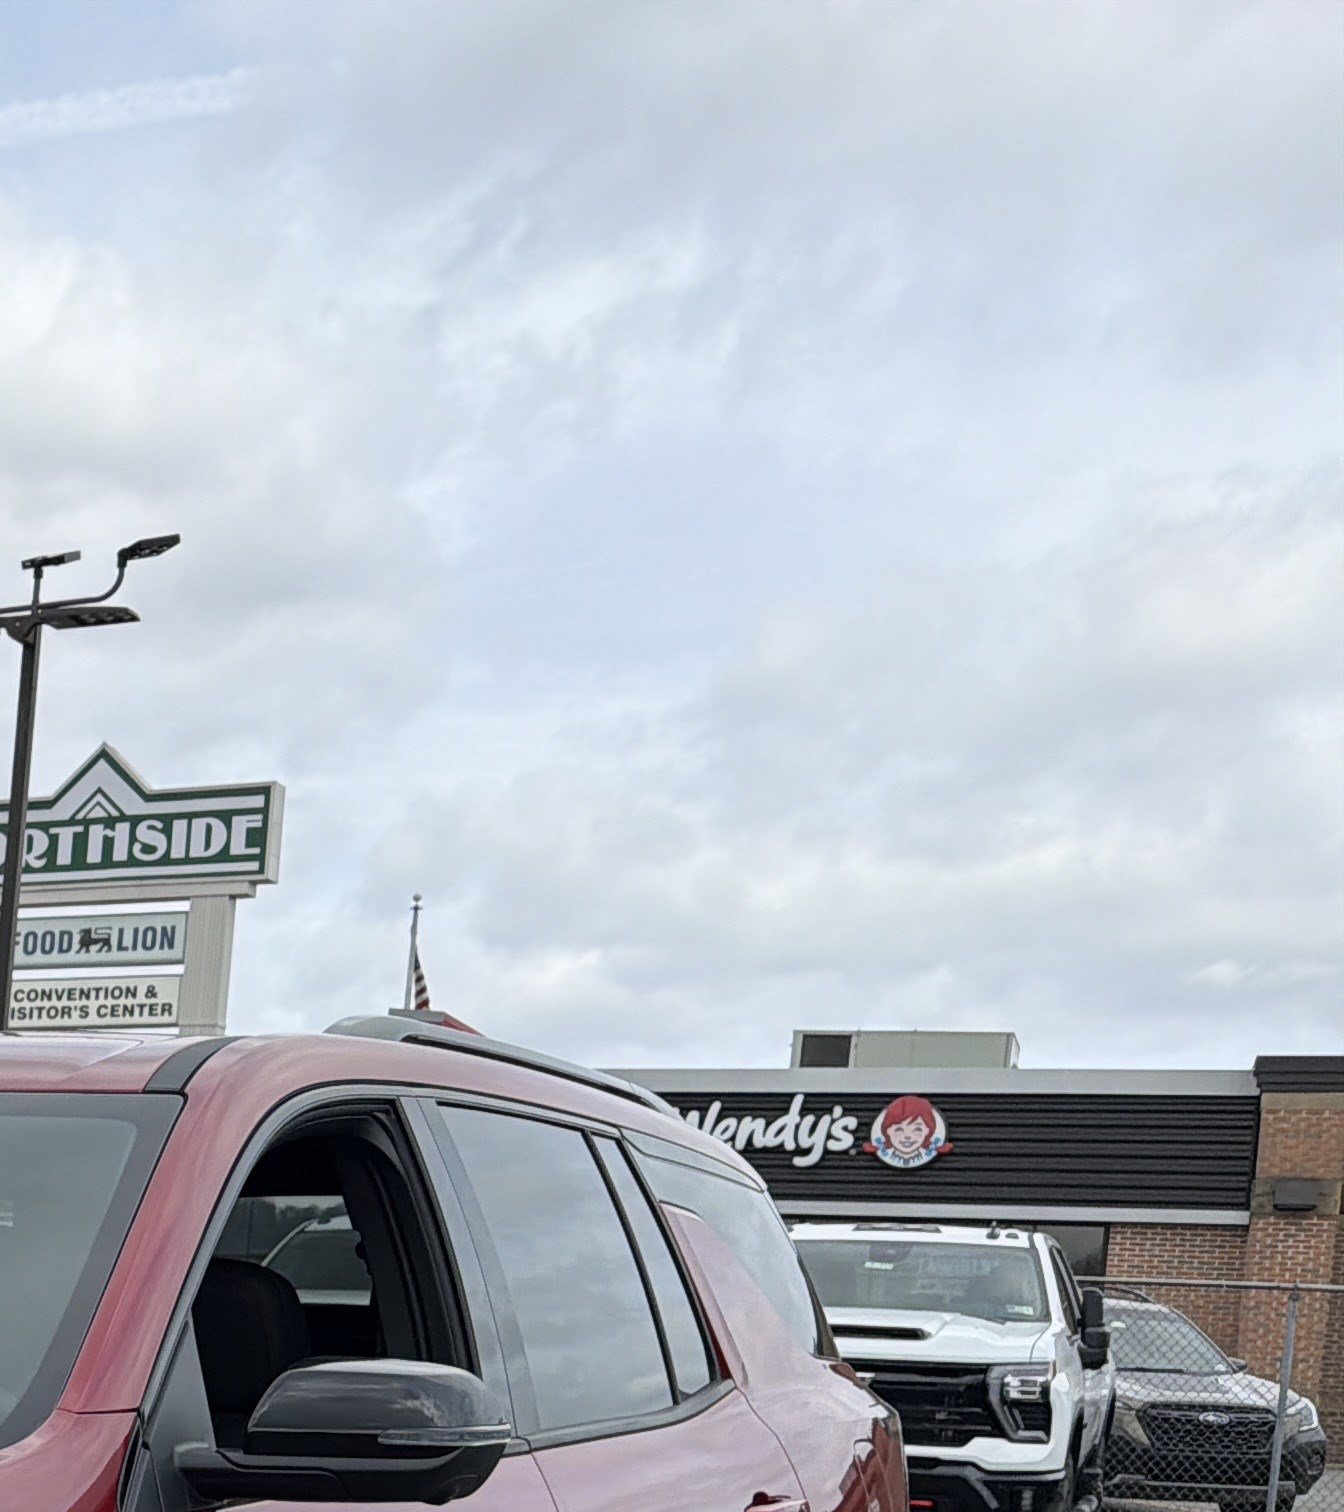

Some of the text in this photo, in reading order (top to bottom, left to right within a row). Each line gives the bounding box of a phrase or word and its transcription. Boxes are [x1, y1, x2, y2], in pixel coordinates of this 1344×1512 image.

[116, 925, 177, 952] LION
[14, 984, 158, 1003] CONVENTION &
[96, 1002, 173, 1018] CENTER
